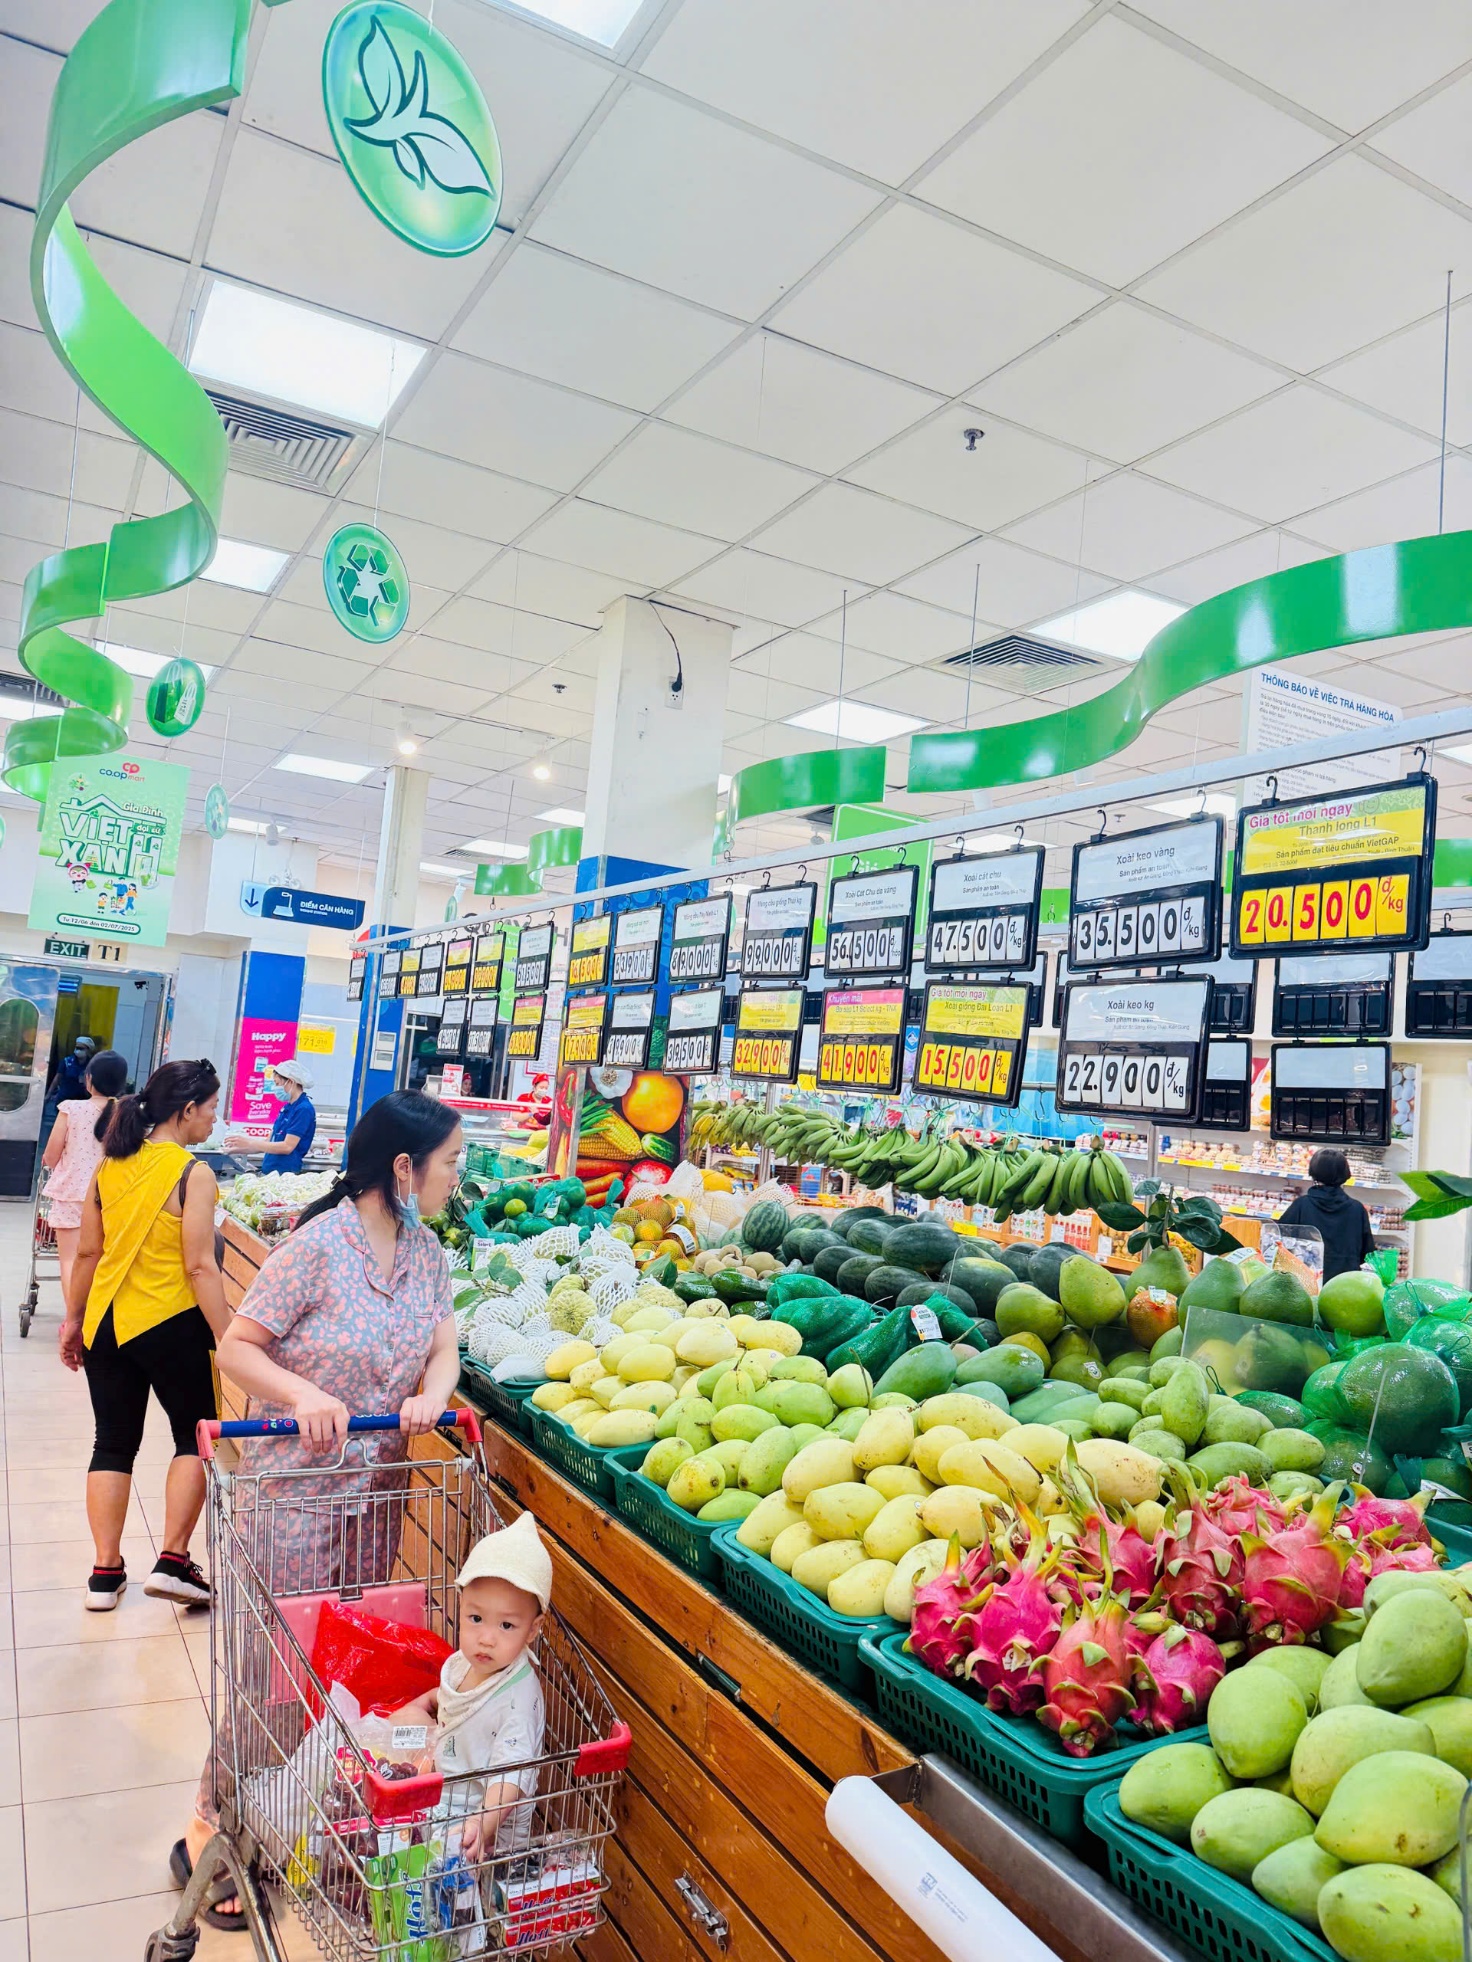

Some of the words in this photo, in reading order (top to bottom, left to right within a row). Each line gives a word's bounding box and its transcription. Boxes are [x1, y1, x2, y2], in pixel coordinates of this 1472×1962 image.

[1261, 672, 1289, 689] THÔNG
[1291, 682, 1307, 695] BÁO
[1309, 687, 1319, 699] VỀ
[1320, 692, 1338, 705] VIỆC
[1356, 702, 1377, 717] HÀNG
[1299, 822, 1333, 837] Thanh
[1336, 818, 1360, 832] long
[1364, 816, 1377, 828] L1
[1117, 852, 1134, 865] Xoài
[1136, 851, 1152, 861] keo
[1154, 847, 1175, 858] vàng
[1291, 847, 1311, 859] phẩm
[1341, 840, 1365, 851] chuẩn
[1366, 836, 1400, 847] VietGAP
[1245, 882, 1372, 933] 20.500
[100, 921, 135, 932] 02/07/2025
[934, 922, 1004, 952] 47.500
[1080, 908, 1177, 950] 35.500
[50, 942, 85, 956] EXIT
[98, 944, 121, 961] T1
[747, 942, 791, 966] 99.000
[831, 933, 886, 961] 56.500
[1107, 1000, 1125, 1010] Xoài
[1127, 1000, 1143, 1009] keo
[1144, 1000, 1155, 1011] kg
[251, 1031, 287, 1042] Happy
[668, 1040, 702, 1062] 39.500
[736, 1042, 780, 1067] 32.900
[823, 1049, 878, 1077] 41.900
[924, 1049, 991, 1081] 15.500
[1068, 1061, 1160, 1094] 22.900
[250, 1101, 272, 1111] Save
